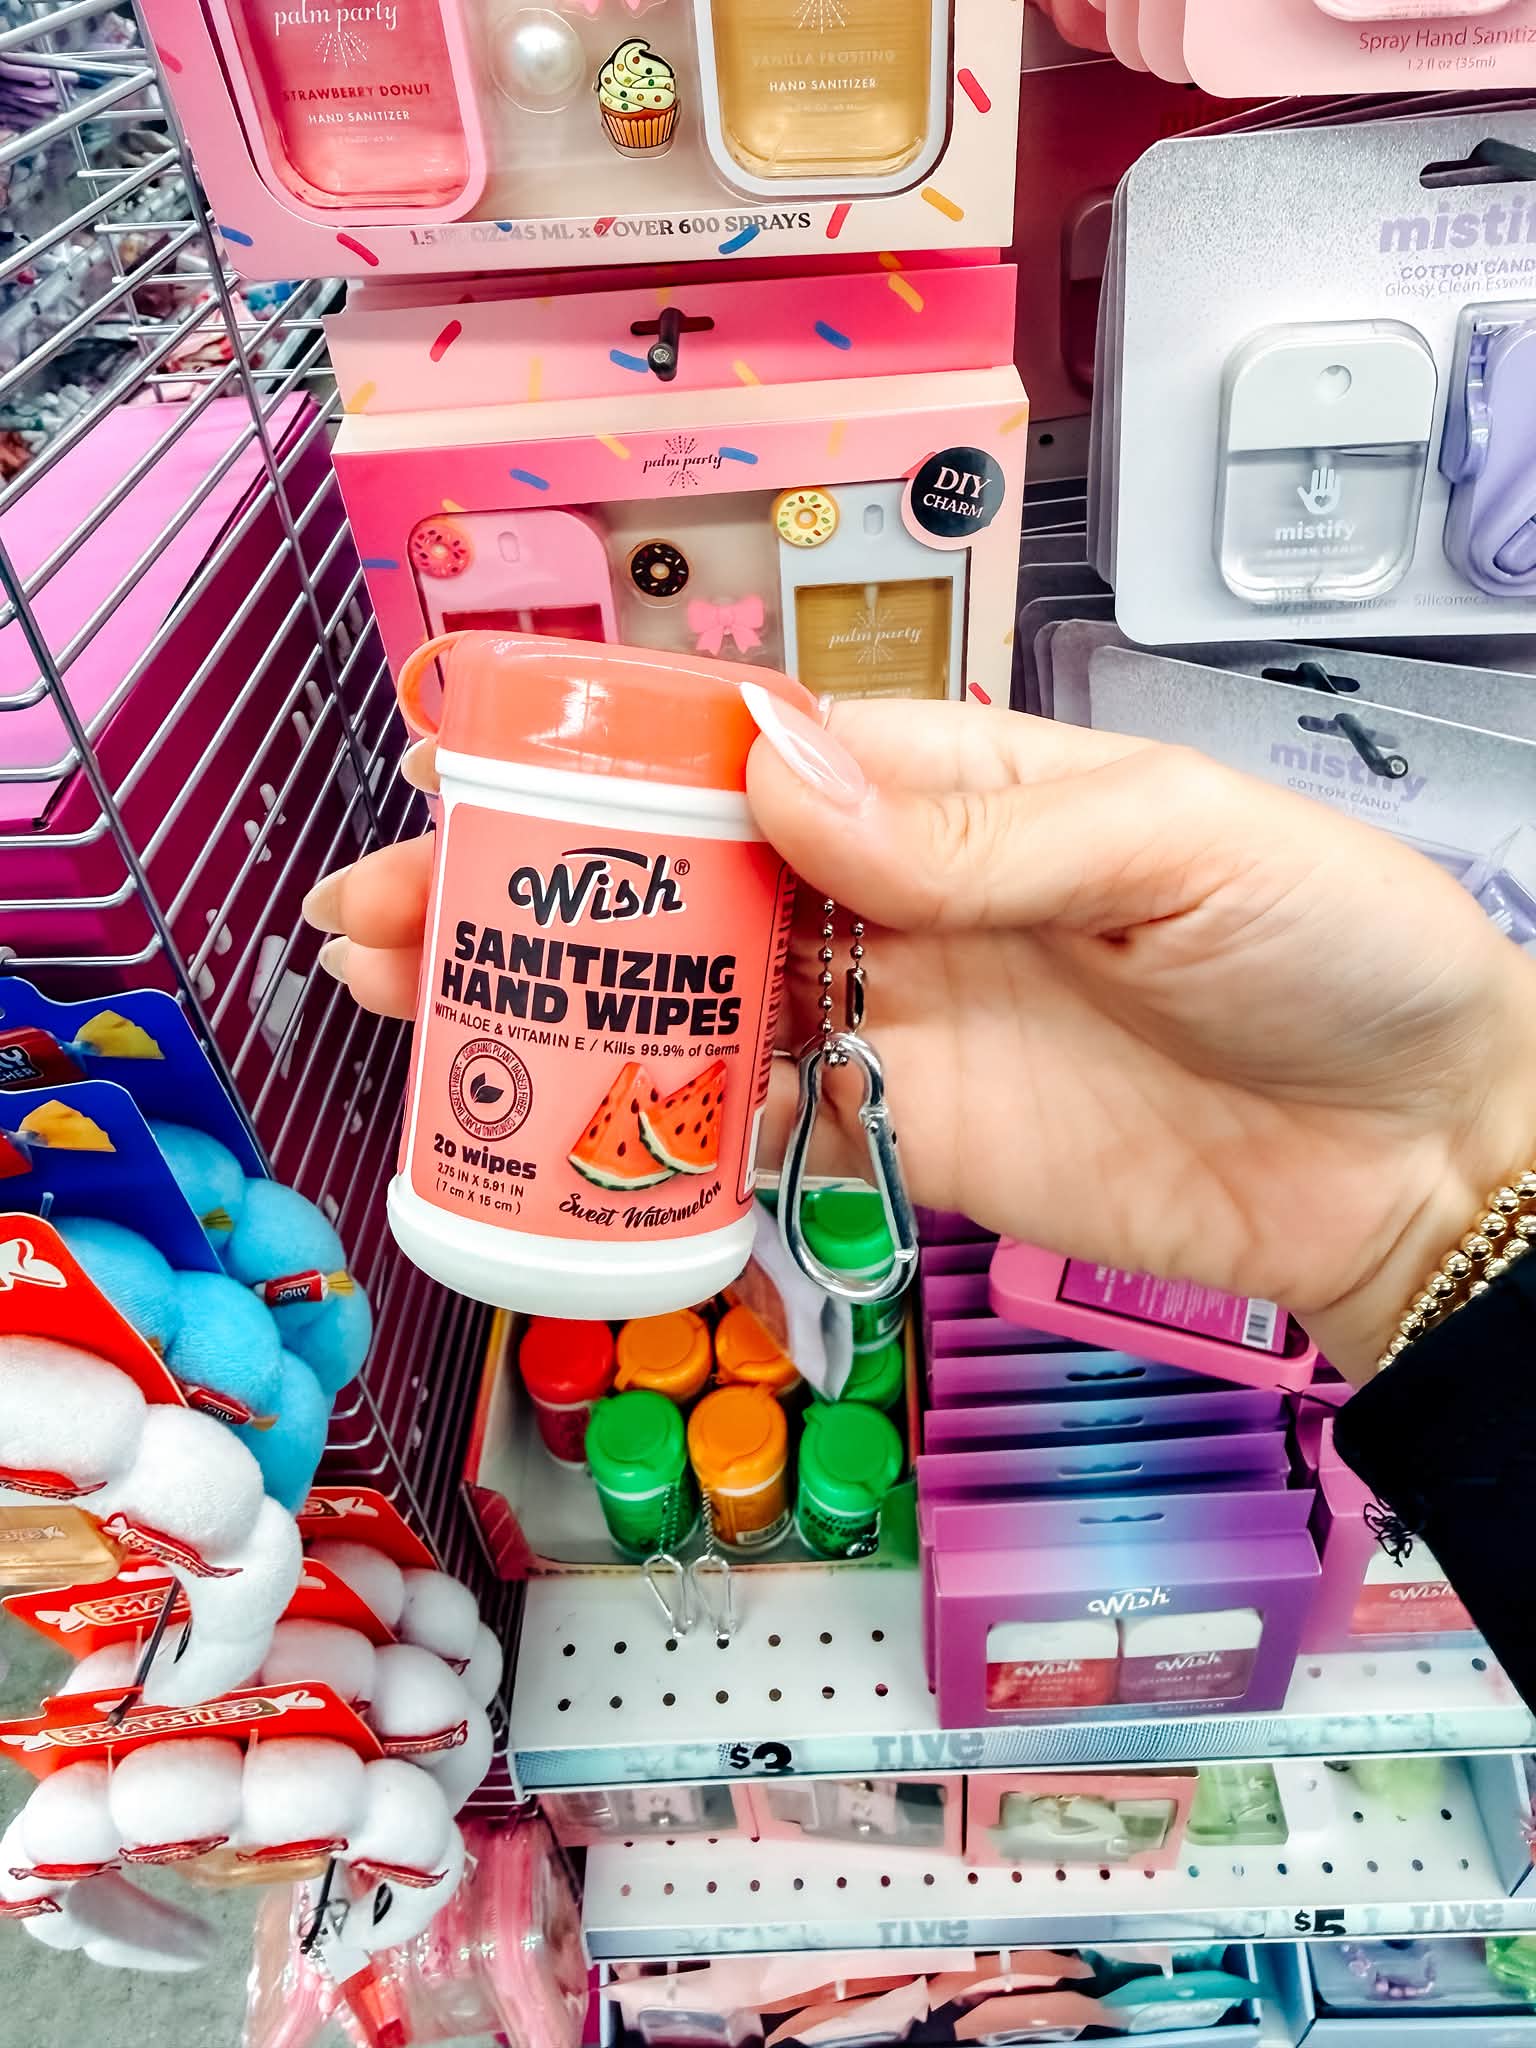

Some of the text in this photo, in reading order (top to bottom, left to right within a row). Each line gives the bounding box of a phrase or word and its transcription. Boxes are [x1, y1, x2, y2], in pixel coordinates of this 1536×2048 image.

[274, 0, 398, 37] palm party
[1360, 32, 1411, 53] Spray
[1416, 27, 1467, 48] Hand
[282, 83, 431, 102] STRAWBERRY DONUT
[769, 78, 877, 92] HAND SANITIZER
[308, 110, 410, 124] HAND SANITIZER
[612, 219, 674, 238] OVER
[679, 218, 720, 235] 600
[725, 213, 811, 233] SPRAYS
[1401, 263, 1478, 280] COTTON
[642, 453, 722, 473] palm party
[933, 466, 993, 498] DIY
[923, 493, 984, 521] CHARM
[1274, 520, 1356, 542] mistify
[829, 623, 922, 649] palm party
[1287, 776, 1400, 813] COTTON CANDY
[455, 920, 737, 995] SANITIZING
[441, 958, 742, 1037] HAND WIPES
[434, 1001, 740, 1057] WITH ALOE & VITAMIN E / Kills 99.9% of Germs
[433, 1133, 537, 1181] 20 wipes
[437, 1162, 525, 1198] 2.75 IN X 5.91 IN
[442, 1179, 448, 1193] 7
[449, 1185, 465, 1200] cm
[467, 1189, 476, 1205] X
[479, 1193, 491, 1206] 15
[494, 1200, 513, 1212] cm
[559, 1180, 722, 1229] Sweet Watermelon
[62, 1703, 264, 1743] SMARTIES
[1294, 1908, 1347, 1937] $5
